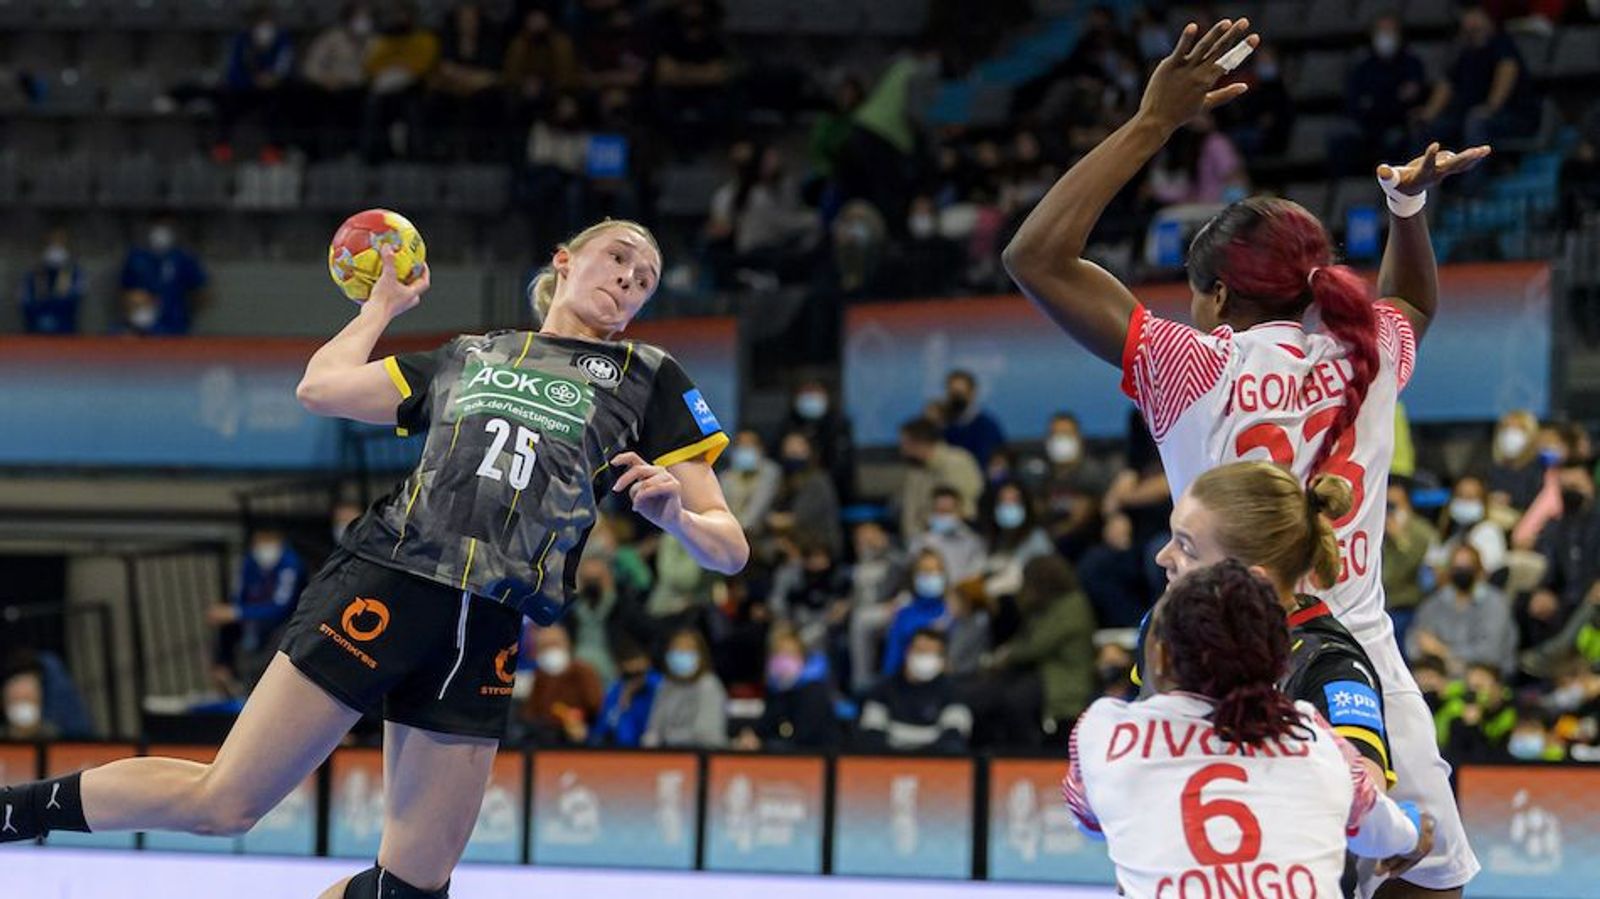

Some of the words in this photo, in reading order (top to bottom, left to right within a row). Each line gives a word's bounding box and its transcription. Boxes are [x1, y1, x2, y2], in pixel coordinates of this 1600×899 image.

[468, 367, 542, 396] AOK
[464, 400, 571, 433] aok.de/leistungen
[476, 418, 540, 490] 25
[1181, 763, 1262, 866] 6
